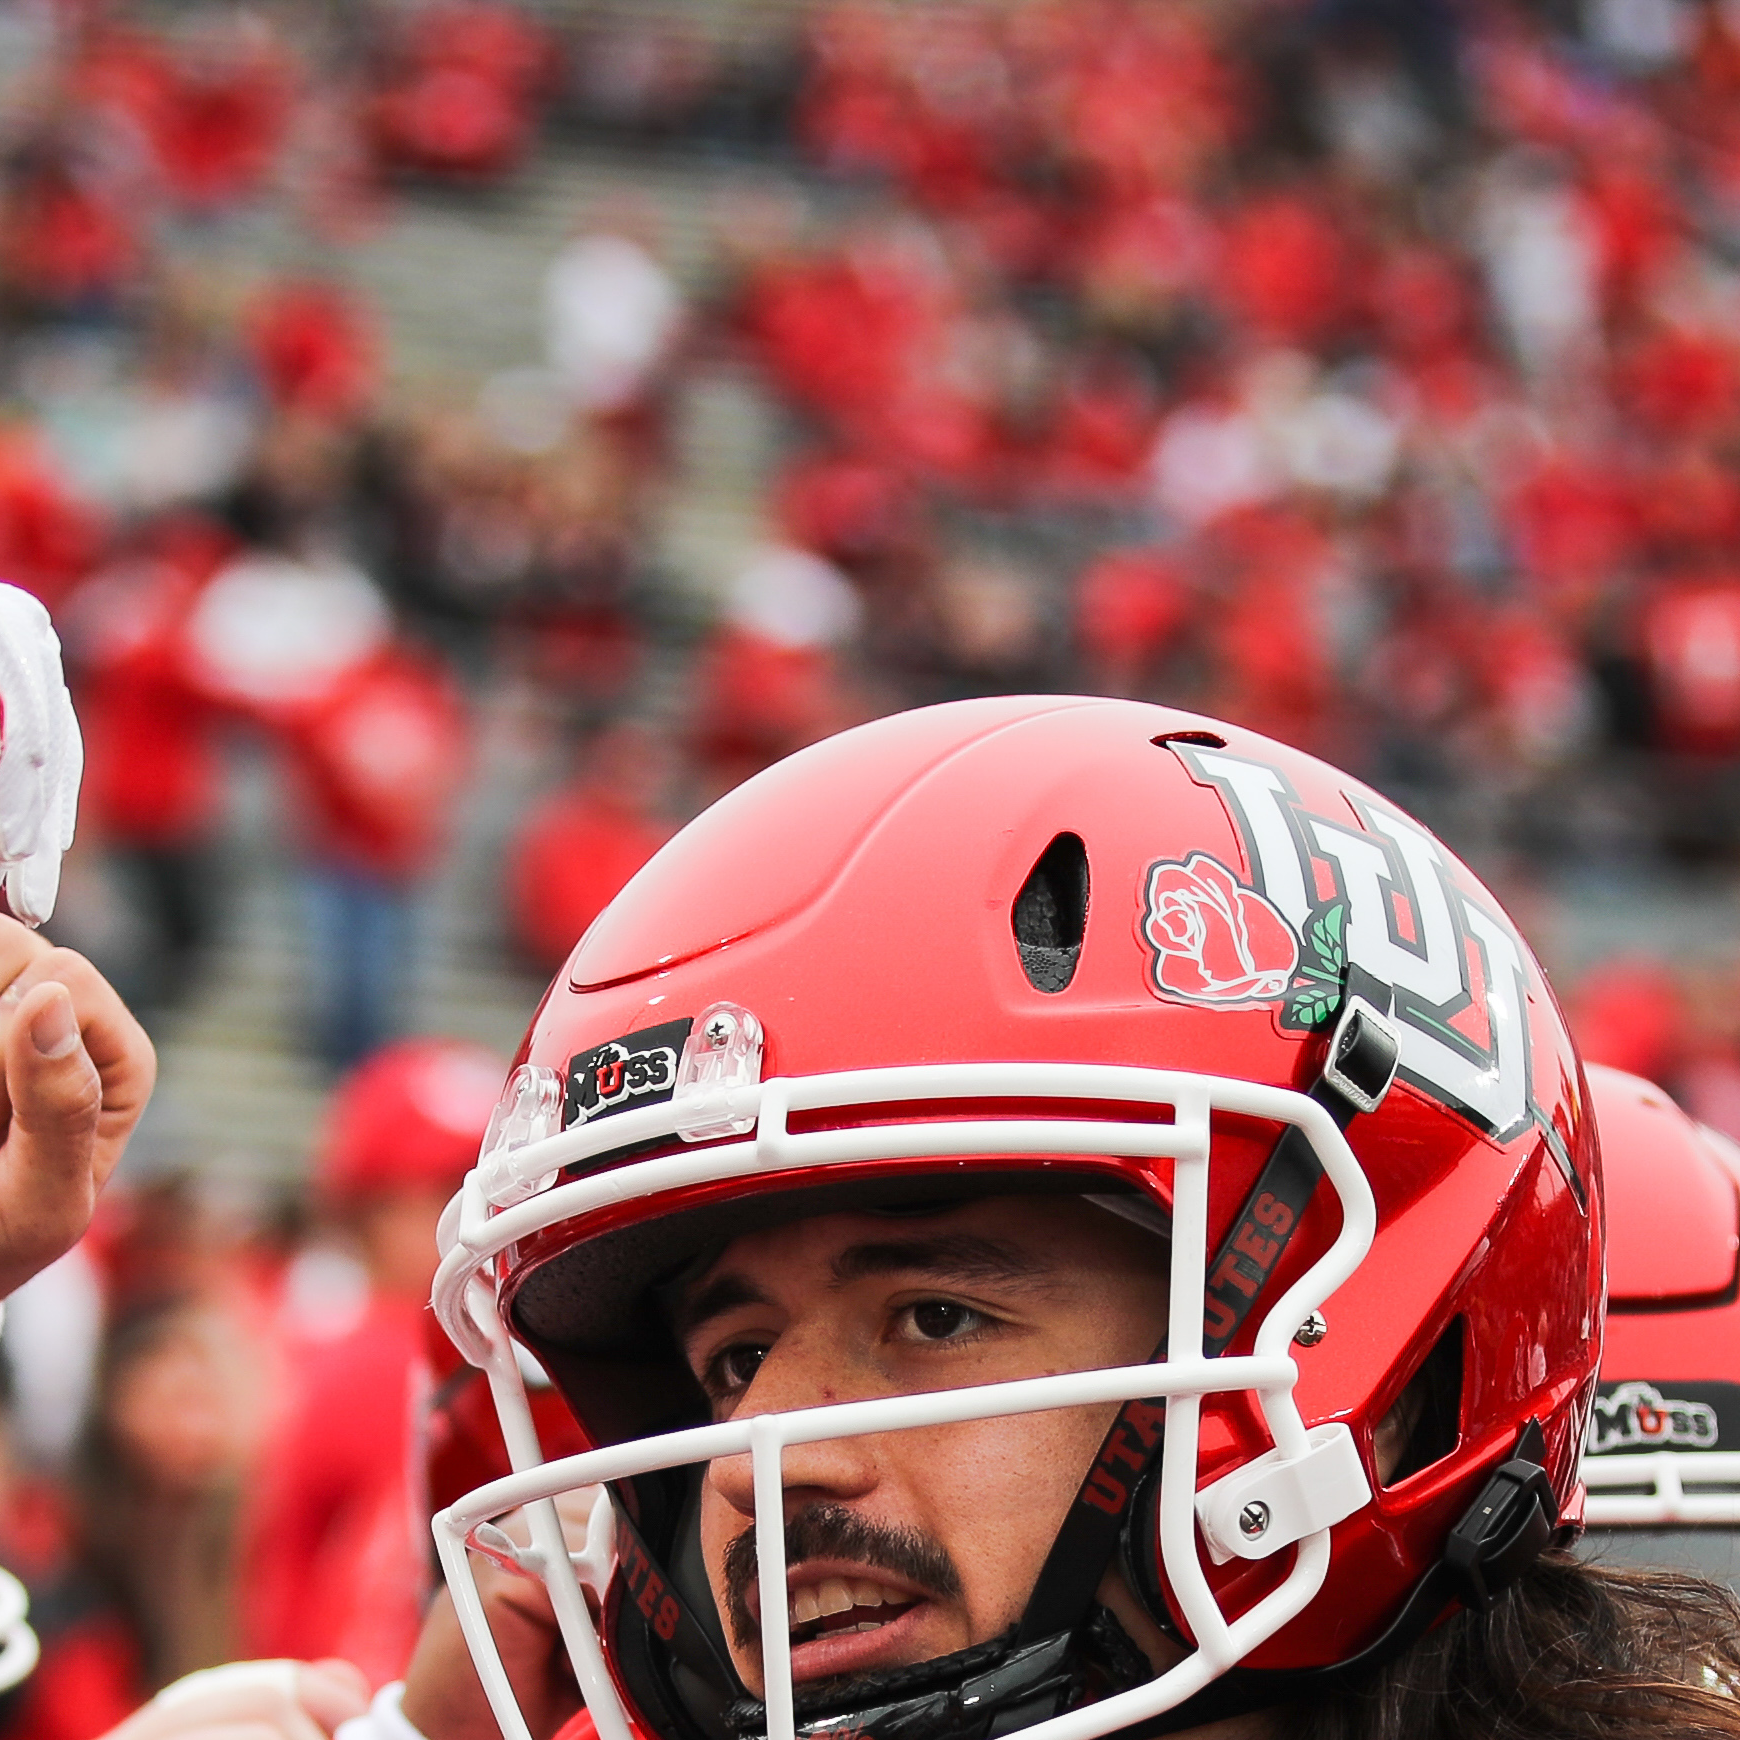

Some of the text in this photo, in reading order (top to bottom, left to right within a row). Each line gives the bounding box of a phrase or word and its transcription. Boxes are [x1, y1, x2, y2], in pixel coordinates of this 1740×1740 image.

[564, 1048, 678, 1130] MUSS
[1085, 1191, 1294, 1515] UTA UTES
[618, 1520, 681, 1641] UTES
